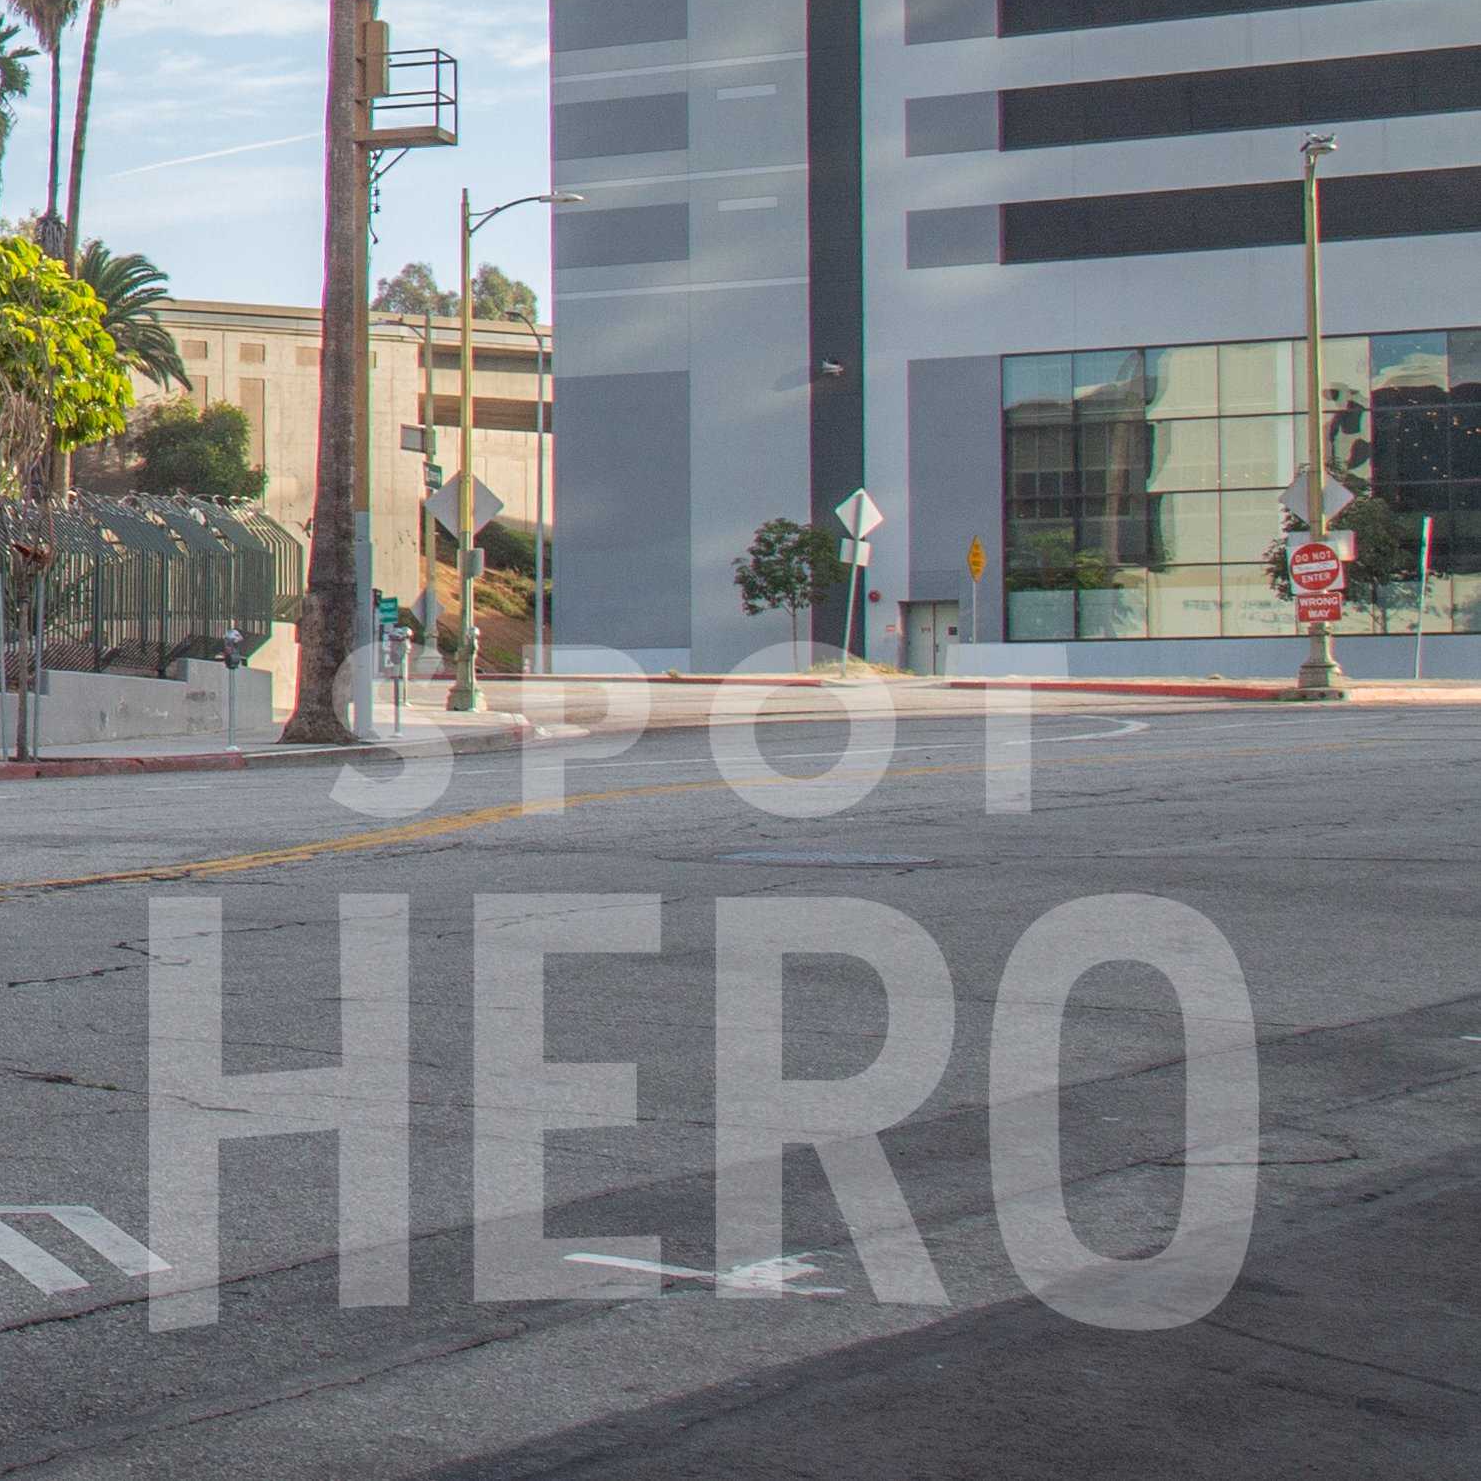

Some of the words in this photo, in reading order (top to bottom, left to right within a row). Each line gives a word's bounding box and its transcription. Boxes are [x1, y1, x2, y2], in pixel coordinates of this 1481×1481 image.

[1294, 553, 1309, 563] DO
[1311, 550, 1331, 560] NOT
[1301, 572, 1330, 583] ENTER
[1299, 597, 1339, 607] WRONG
[1308, 609, 1330, 617] WAY
